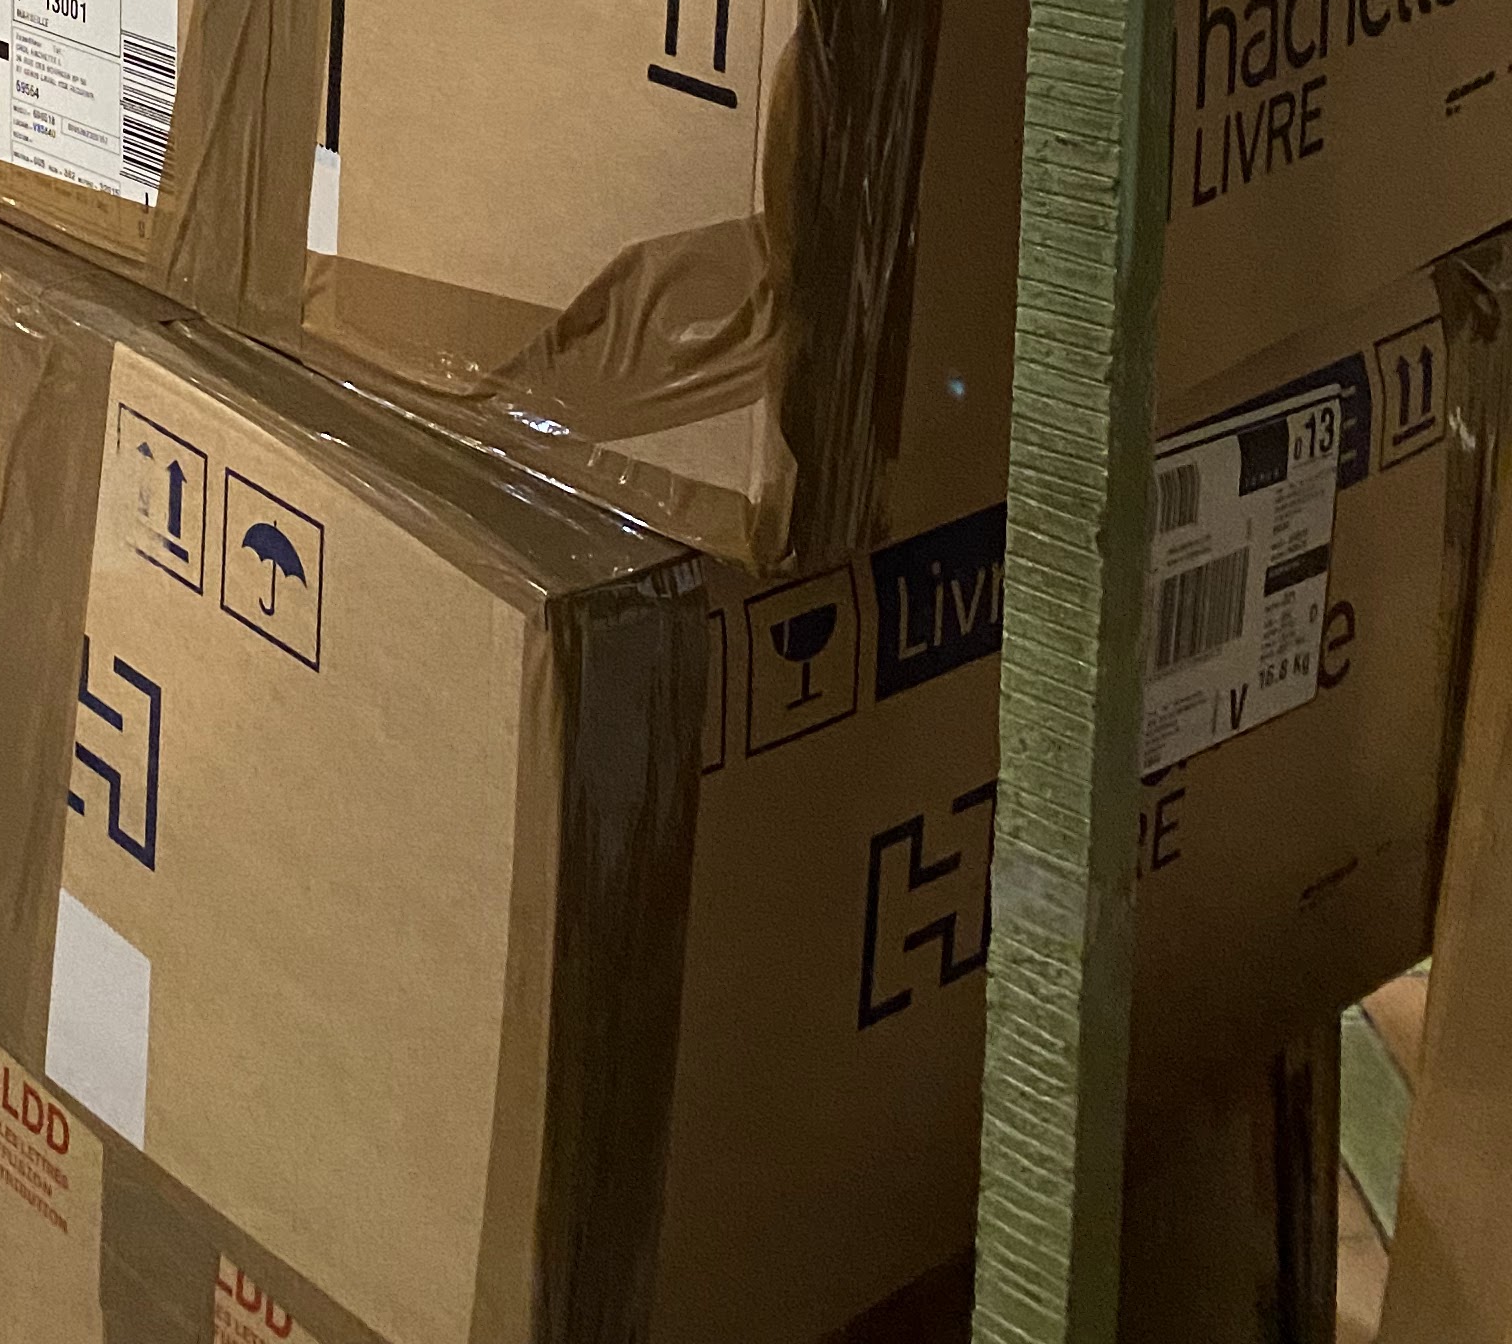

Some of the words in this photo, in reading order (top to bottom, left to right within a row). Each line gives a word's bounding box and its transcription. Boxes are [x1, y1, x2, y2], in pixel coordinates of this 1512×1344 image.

[15, 78, 40, 101] 69564
[1192, 74, 1327, 208] LIVRE
[1229, 684, 1248, 732] V
[22, 1140, 71, 1191] LETTRES
